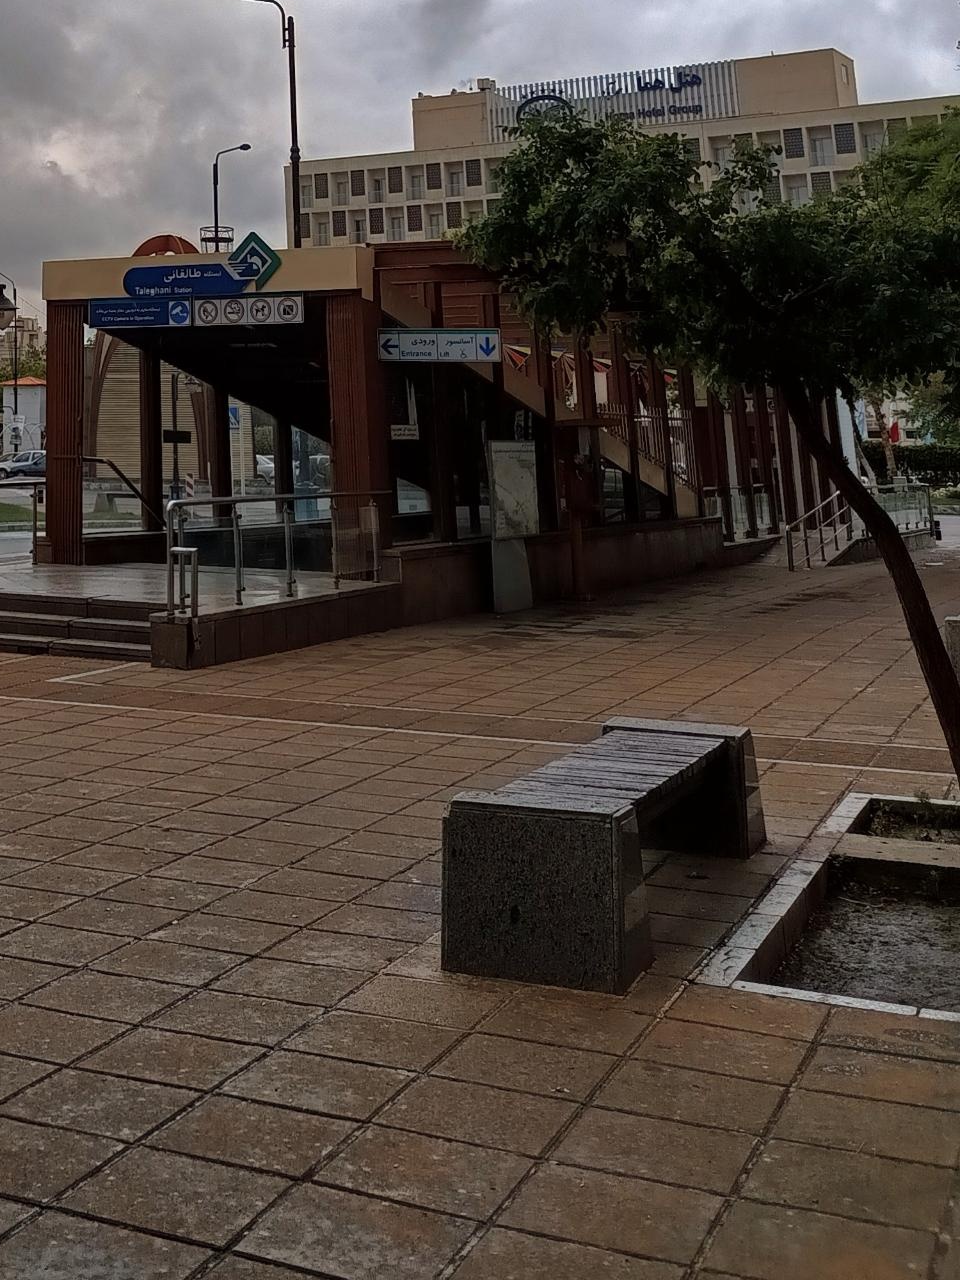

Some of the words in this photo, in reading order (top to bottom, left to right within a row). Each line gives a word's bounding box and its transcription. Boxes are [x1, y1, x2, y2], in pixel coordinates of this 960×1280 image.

[636, 76, 665, 91] هما
[670, 72, 702, 93] هتل
[638, 107, 665, 118] Hotel
[669, 104, 702, 115] Group
[163, 268, 202, 283] طالقانی
[134, 286, 172, 296] Taleghani
[411, 337, 435, 346] ورودی
[445, 336, 474, 347] آسانسور
